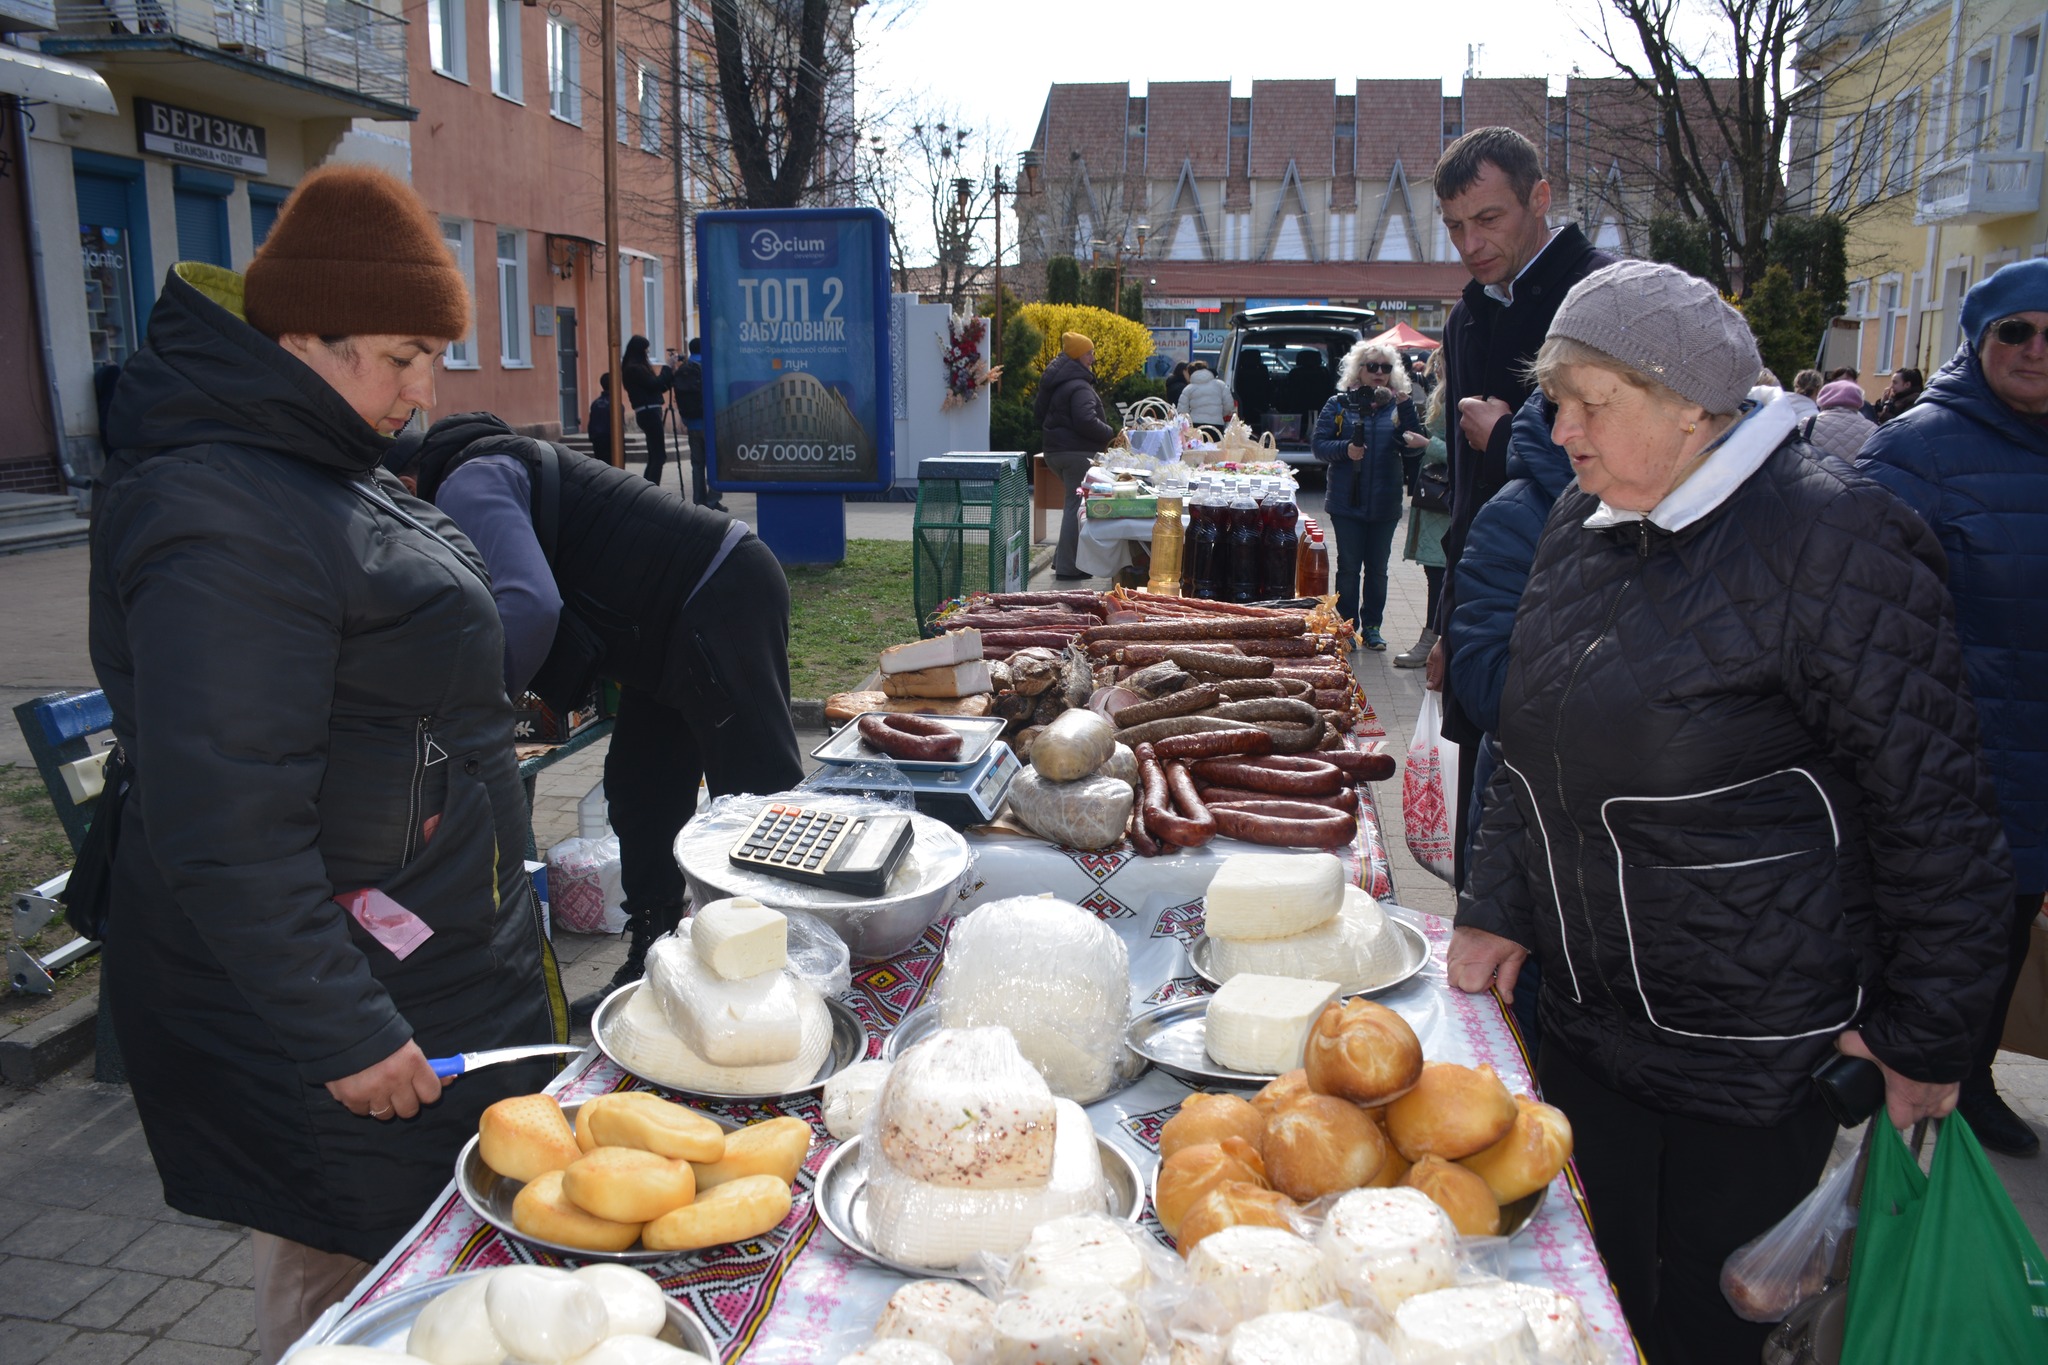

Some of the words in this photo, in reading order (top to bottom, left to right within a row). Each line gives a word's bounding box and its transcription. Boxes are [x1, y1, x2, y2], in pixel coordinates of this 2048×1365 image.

[151, 104, 260, 155] БЕРІЗКА
[761, 236, 825, 252] Socium
[80, 246, 124, 270] tlantic
[738, 278, 809, 323] ТОП
[822, 276, 844, 323] 2
[1379, 300, 1407, 311] ANDI
[739, 320, 846, 344] ЗАБУДОВНИК
[1153, 340, 1189, 348] НАЛІЗИ
[784, 359, 808, 371] лун
[737, 444, 769, 461] 067
[772, 444, 824, 461] 0000
[827, 444, 857, 461] 215
